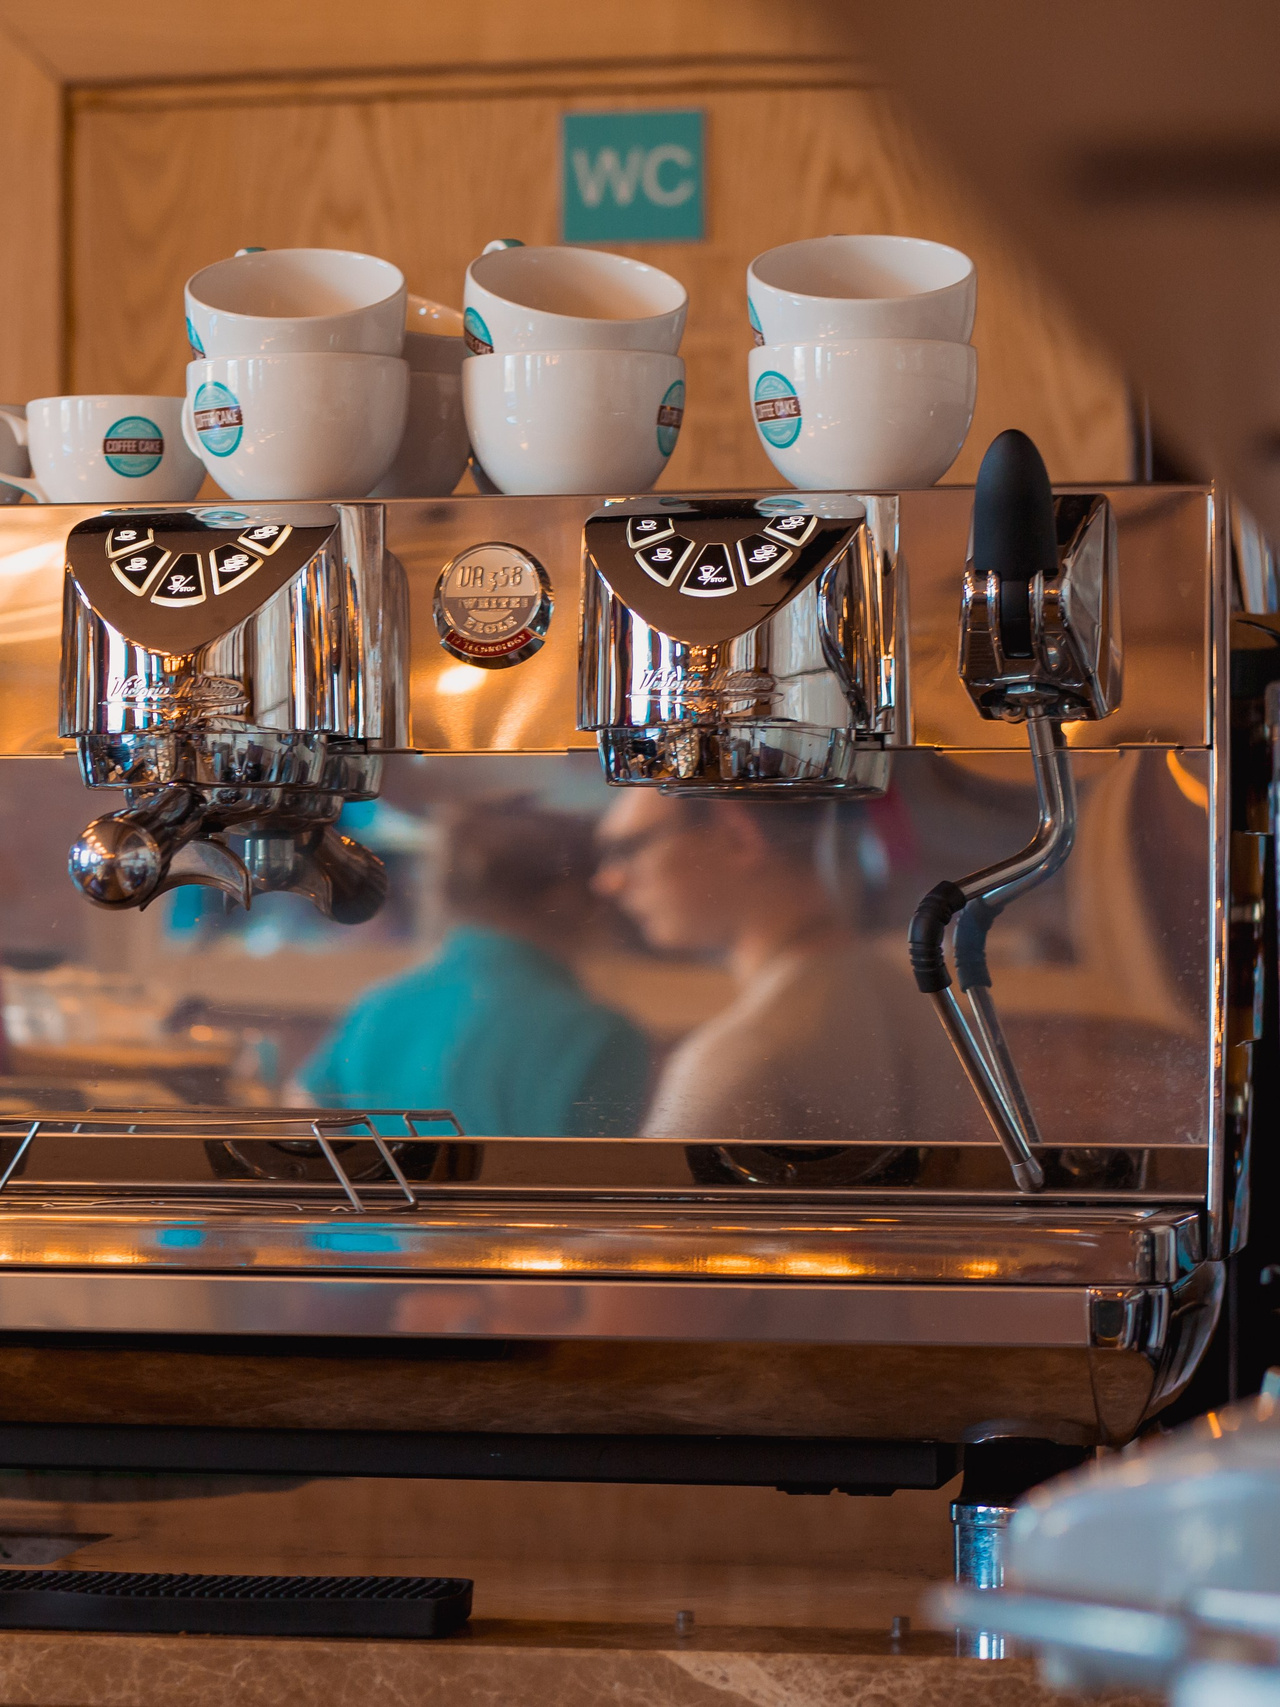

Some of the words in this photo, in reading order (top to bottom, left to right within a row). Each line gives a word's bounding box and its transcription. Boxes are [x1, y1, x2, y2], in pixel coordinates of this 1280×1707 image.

[573, 144, 695, 208] WC
[216, 408, 239, 426] CAKE
[106, 440, 137, 452] COFFEE
[139, 441, 160, 452] CAKE
[487, 566, 523, 593] 358
[461, 598, 520, 609] WHITE
[111, 675, 170, 697] Victoria
